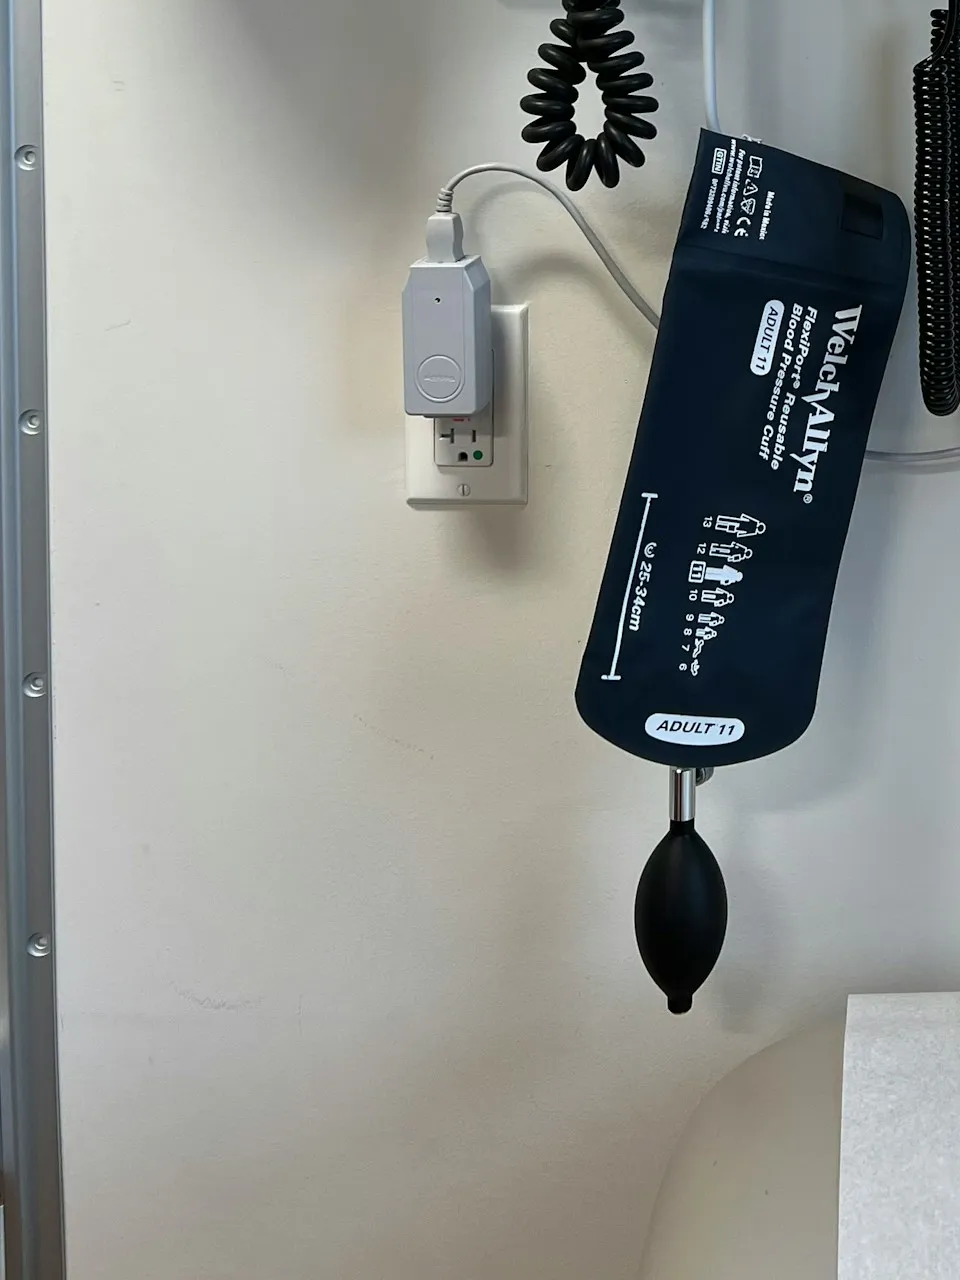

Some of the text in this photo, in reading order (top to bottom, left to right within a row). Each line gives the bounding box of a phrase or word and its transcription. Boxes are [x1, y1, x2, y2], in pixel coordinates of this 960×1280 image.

[714, 151, 724, 172] GTIN
[755, 306, 779, 371] ADULT 11
[759, 303, 804, 461] Blood Pressure Cuff
[771, 392, 796, 470] Reusable
[702, 516, 712, 528] 13
[697, 542, 707, 554] 12
[691, 565, 702, 578] 11
[629, 560, 652, 632] 25-34cm
[688, 589, 698, 601] 10
[685, 613, 694, 622] 9
[683, 628, 692, 636] 8
[681, 644, 690, 652] 7
[678, 663, 688, 671] 6
[656, 720, 736, 736] ADULT 11
